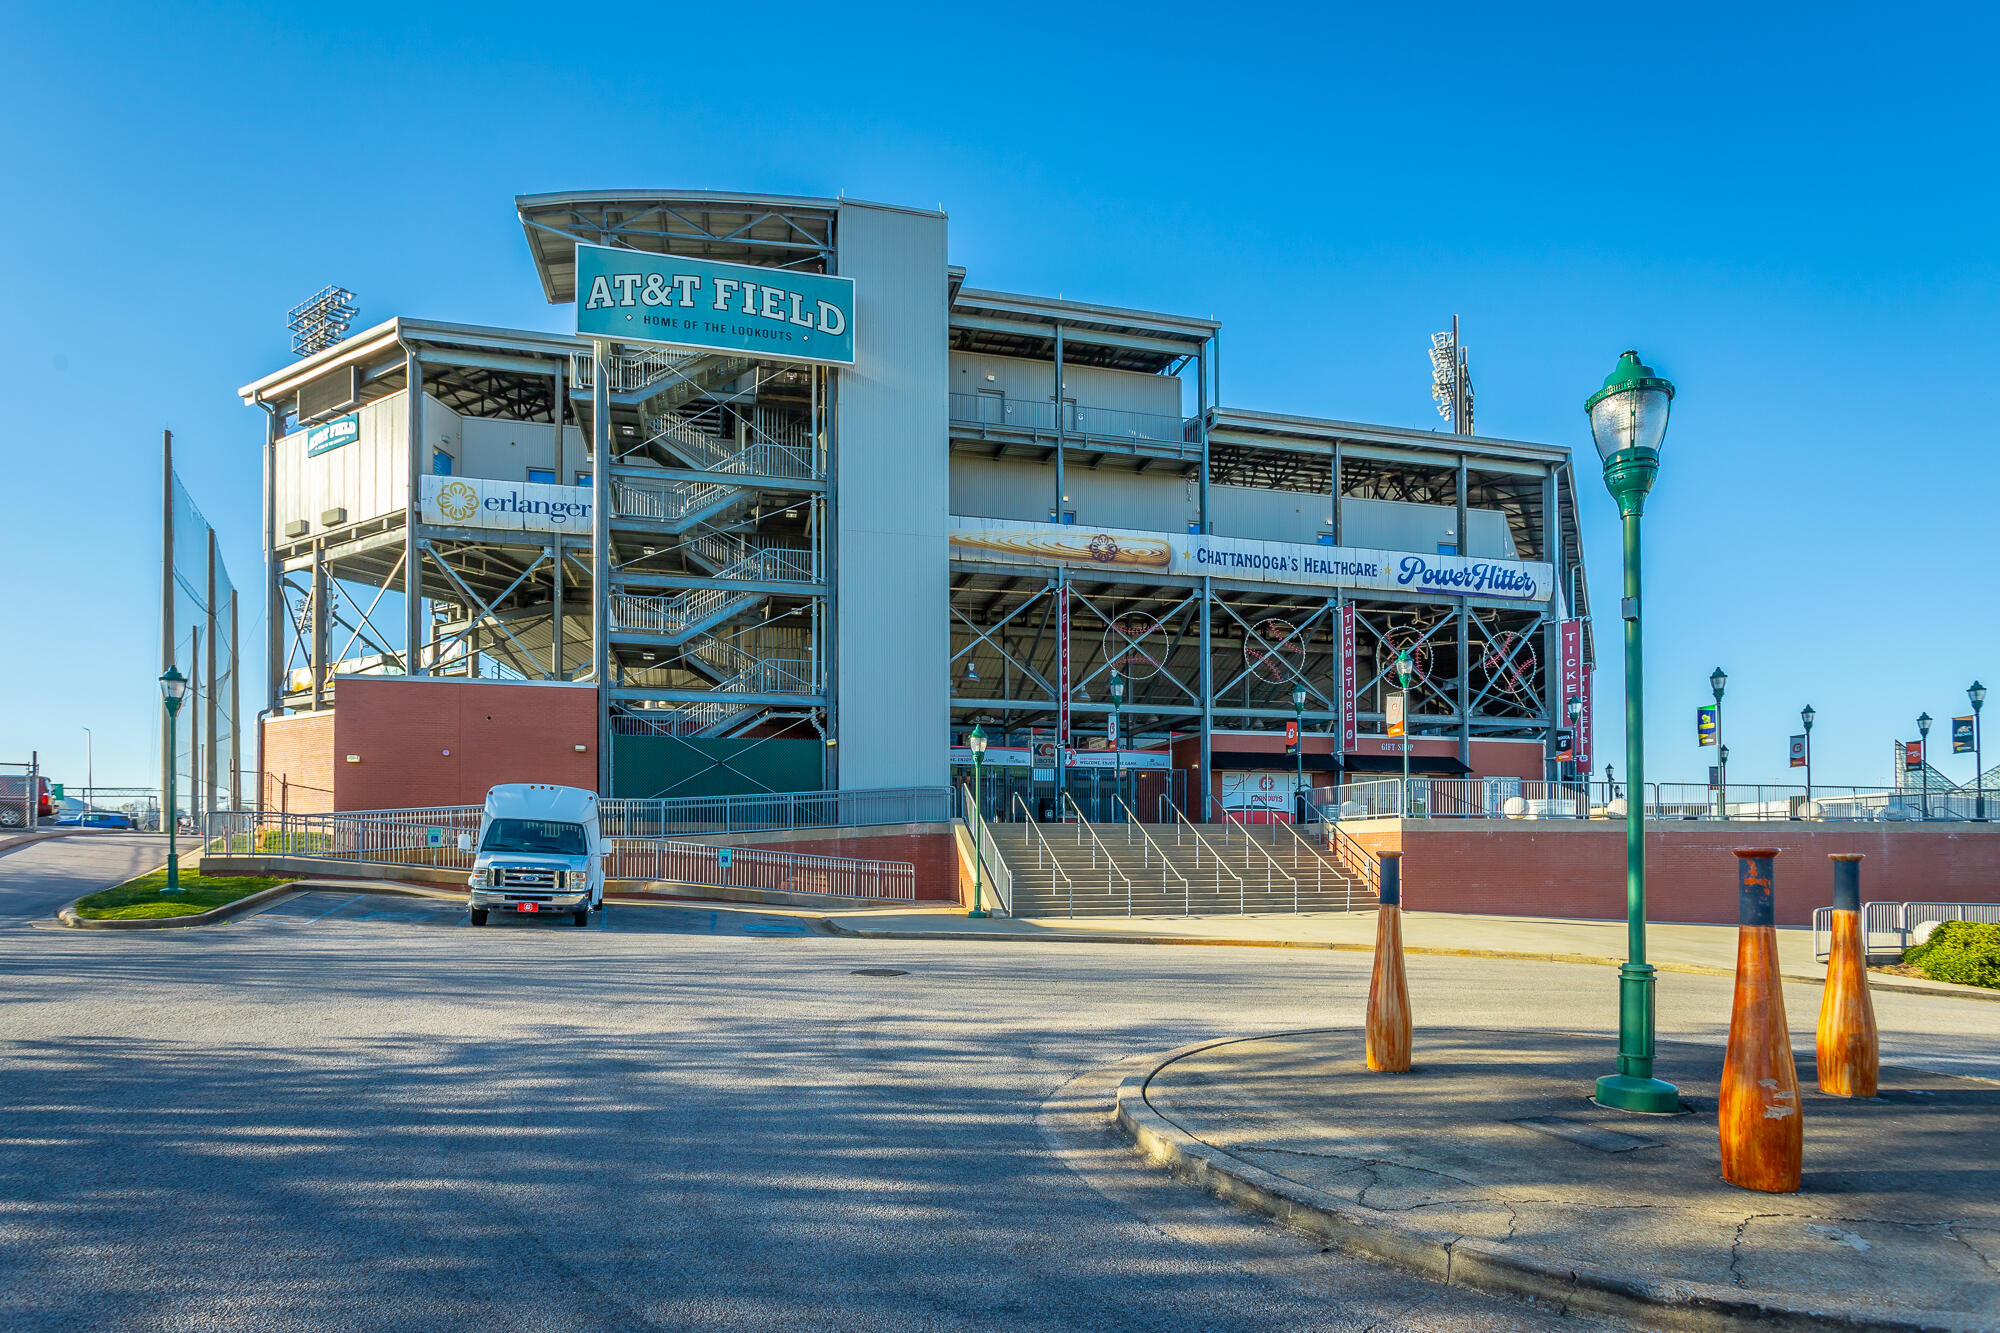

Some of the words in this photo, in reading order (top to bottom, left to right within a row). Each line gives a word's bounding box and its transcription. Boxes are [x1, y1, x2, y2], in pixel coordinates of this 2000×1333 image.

[585, 272, 702, 310] AT&T
[712, 277, 847, 337] FIELD
[643, 314, 678, 328] HOME
[684, 319, 699, 330] OF
[704, 322, 726, 334] THE
[732, 325, 793, 342] LOOKOUTS
[484, 491, 592, 524] erlanger
[1197, 548, 1298, 572] CHATTANOOGA'S
[1304, 557, 1378, 577] HEALTHCARE
[1565, 632, 1577, 719] TICKE
[1345, 666, 1353, 722] STORE
[1381, 742, 1396, 751] GIFT
[1397, 743, 1414, 752] SP
